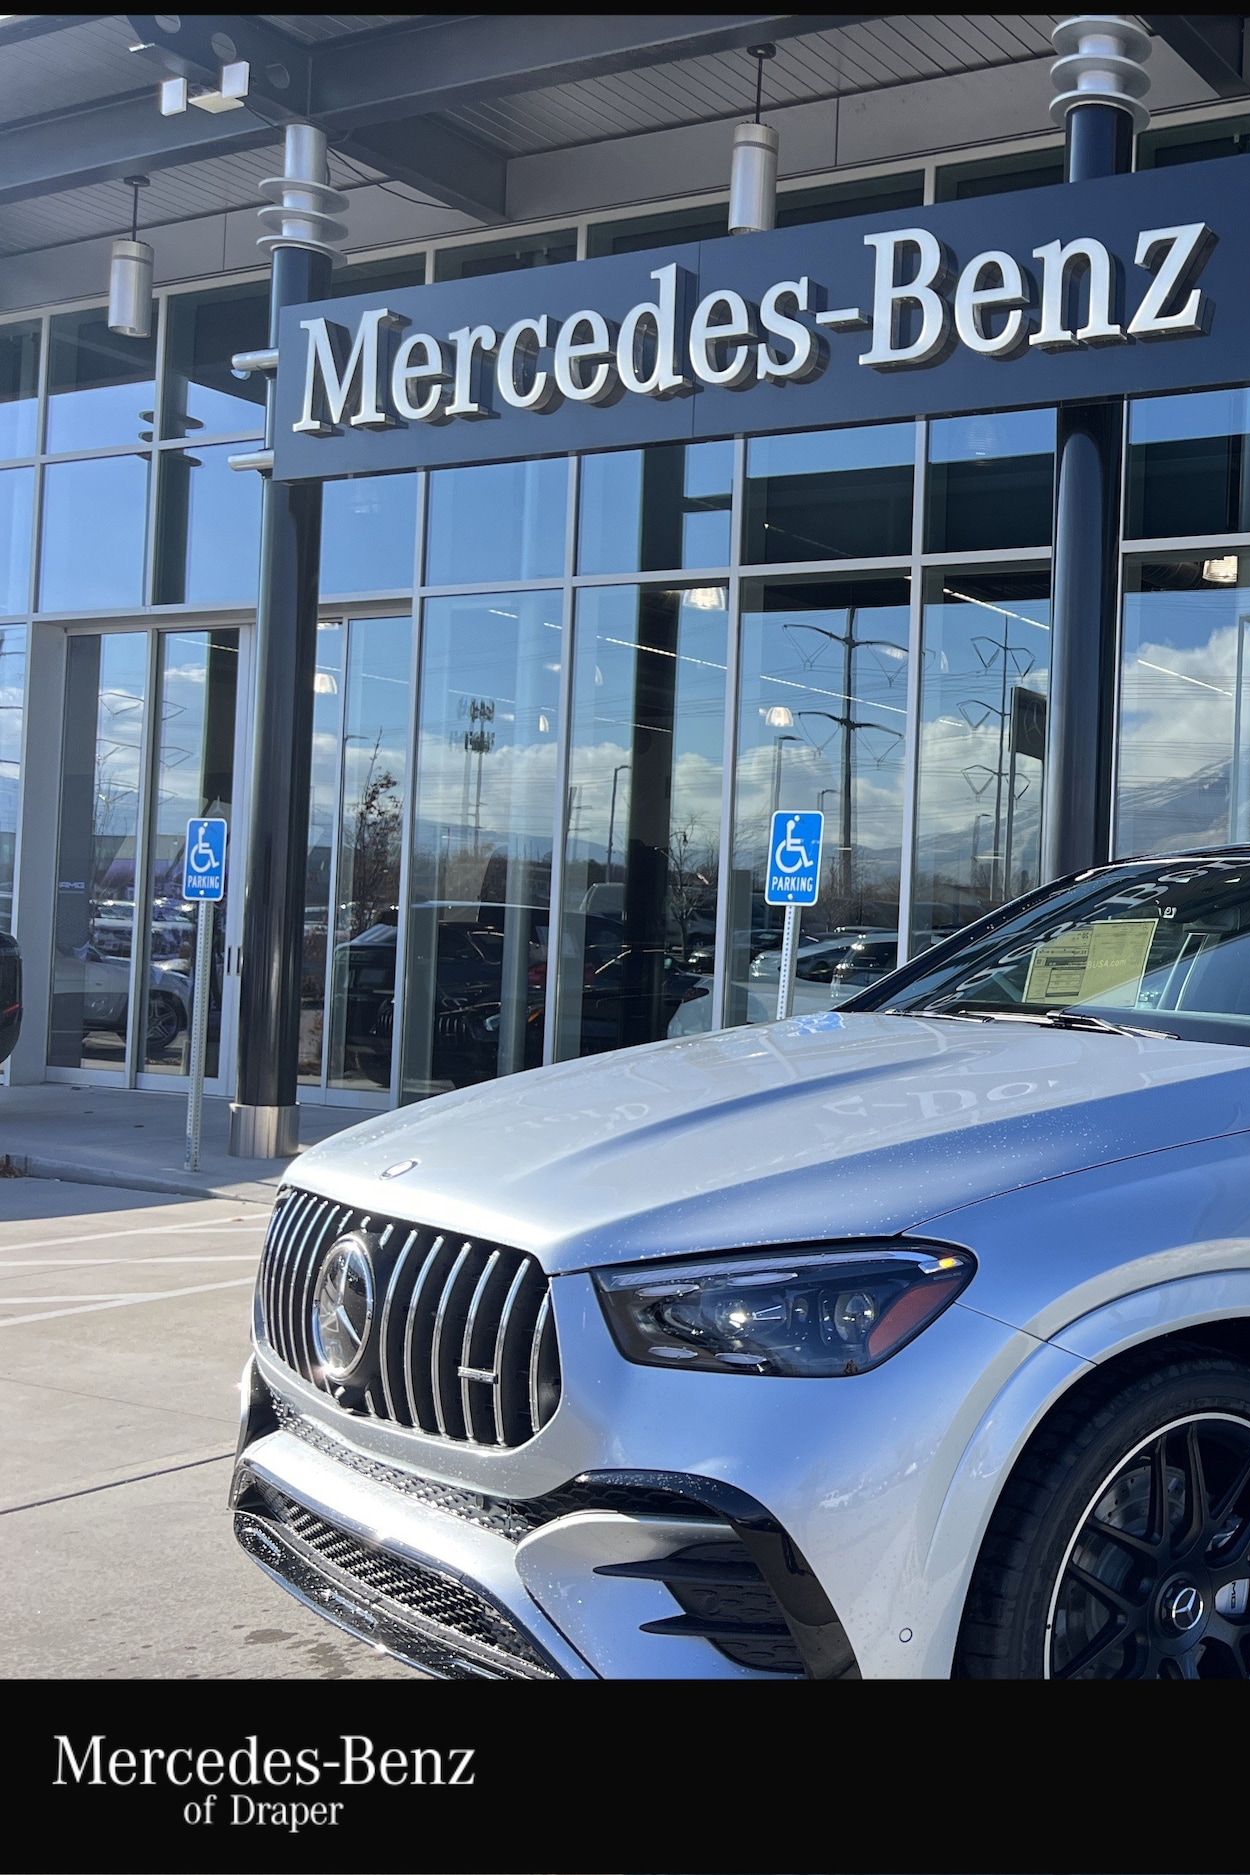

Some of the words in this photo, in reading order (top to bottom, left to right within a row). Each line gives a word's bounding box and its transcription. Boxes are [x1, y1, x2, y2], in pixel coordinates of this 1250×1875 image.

[291, 221, 1208, 433] Mercedes-Benz
[187, 874, 220, 889] PARKING
[771, 875, 814, 893] PARKING
[1086, 959, 1127, 969] BUSA.com
